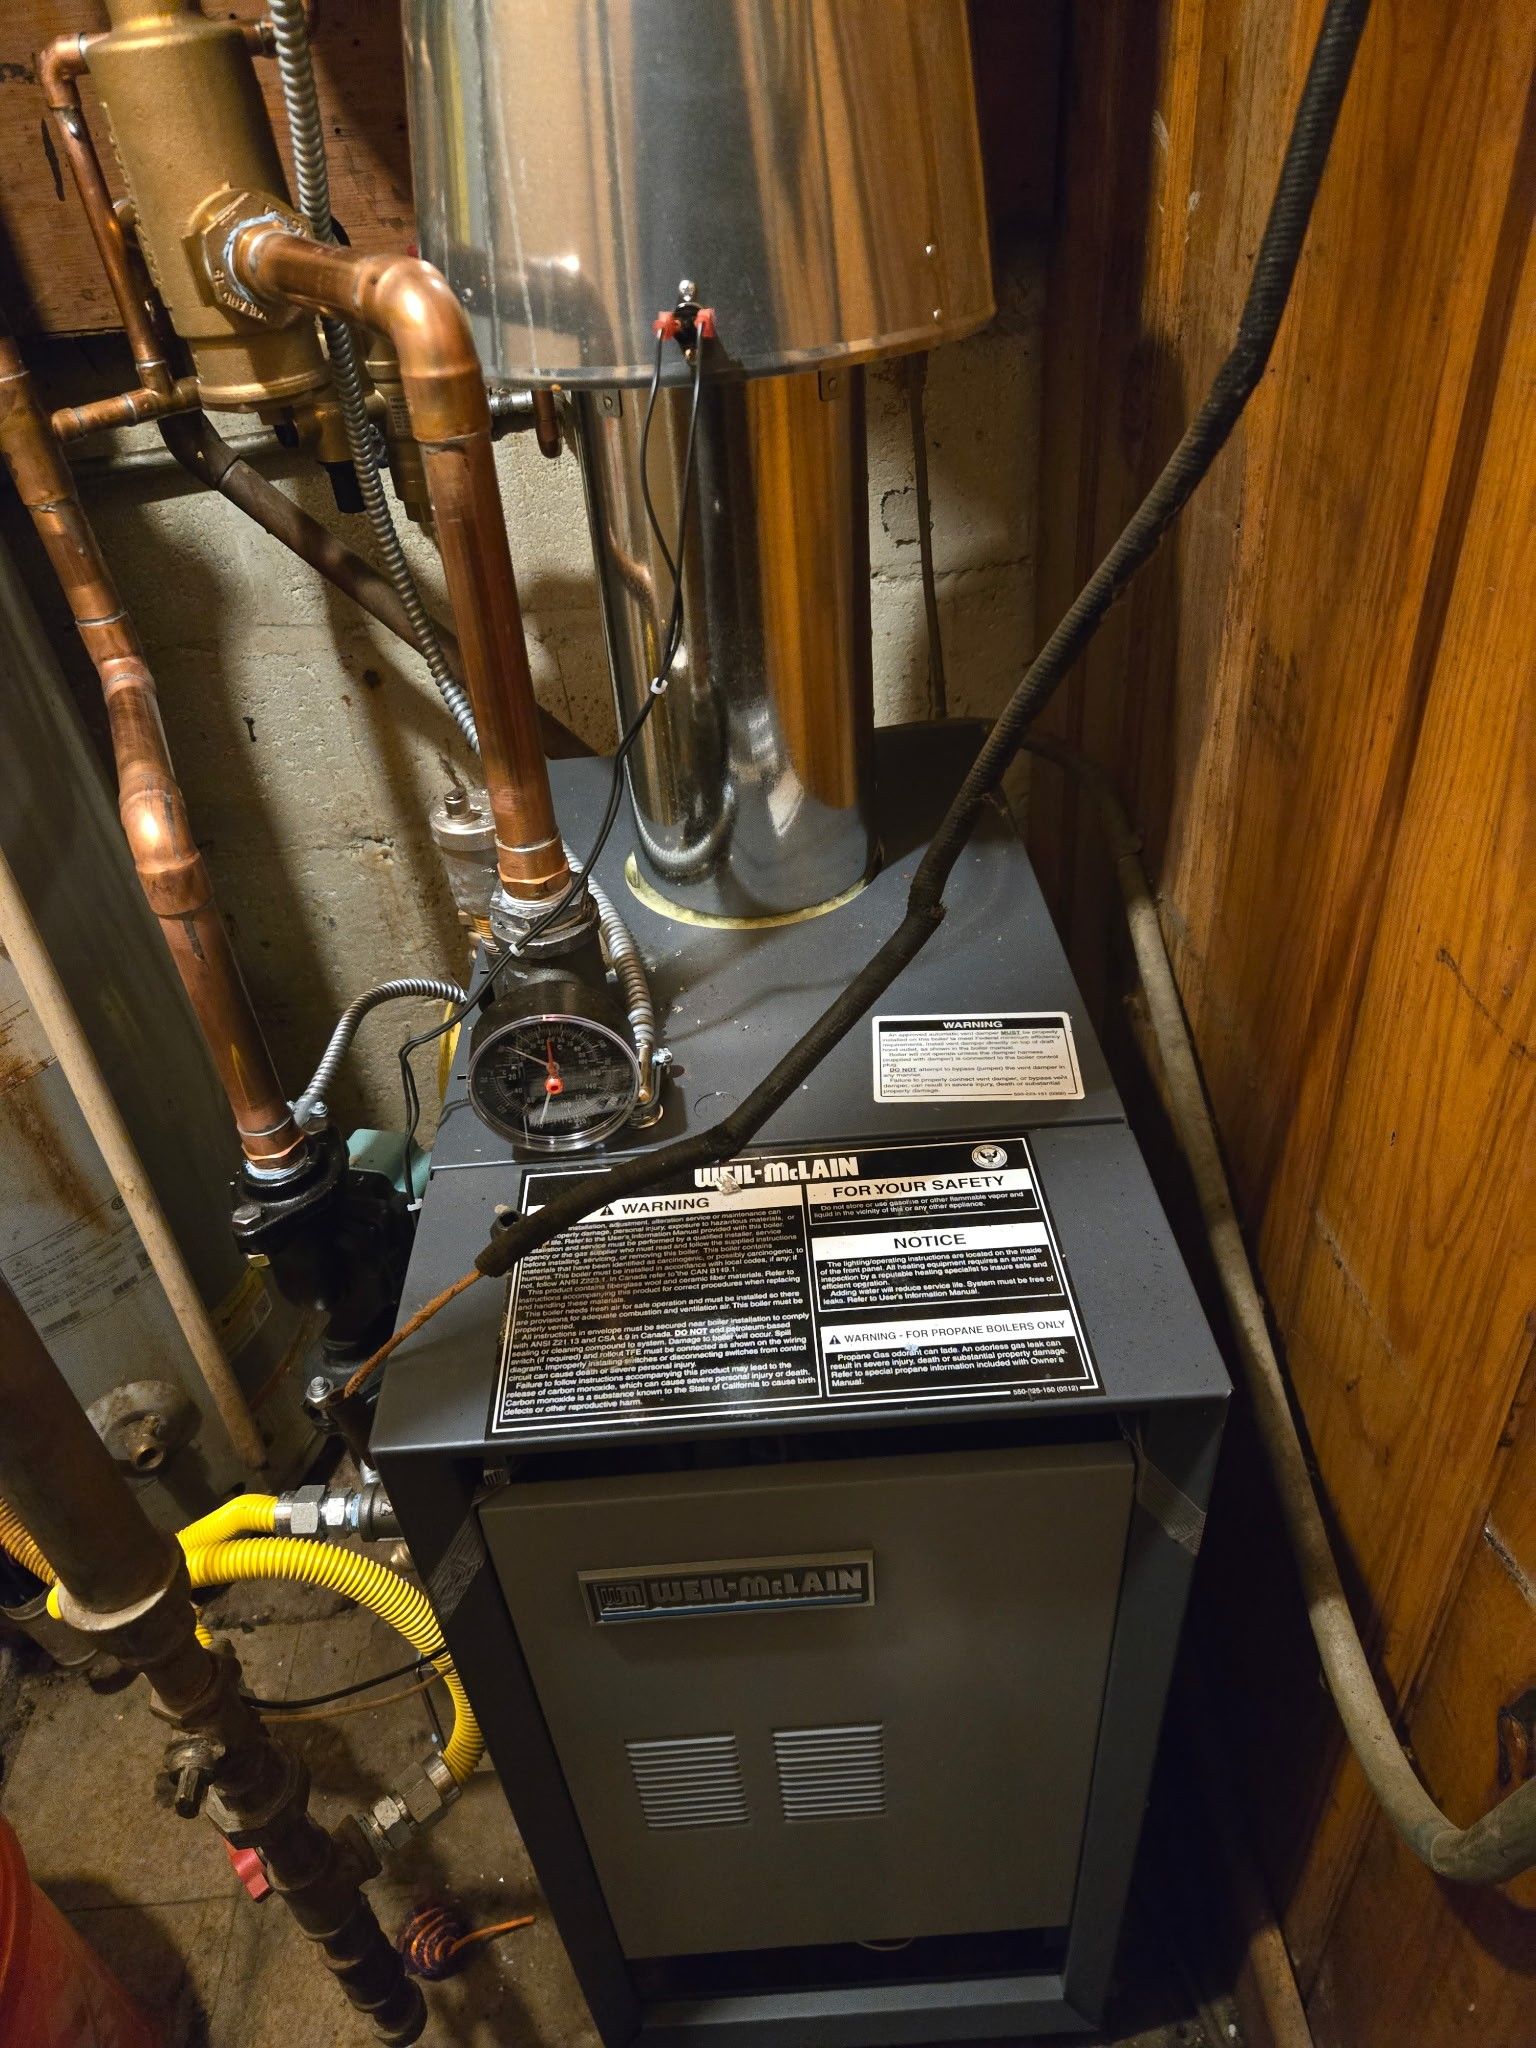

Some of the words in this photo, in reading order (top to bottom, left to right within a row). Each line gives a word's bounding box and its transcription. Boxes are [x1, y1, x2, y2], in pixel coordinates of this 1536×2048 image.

[943, 1021, 1004, 1029] WARNING
[833, 1185, 872, 1198] FOR
[875, 1181, 927, 1195] YOUR
[932, 1176, 1006, 1191] SAFETY
[622, 1198, 709, 1214] WARNING
[855, 1207, 881, 1216] vicinity
[948, 1200, 986, 1210] appliance.
[894, 1234, 967, 1249] NOTICE
[827, 1260, 842, 1268] The
[907, 1253, 951, 1262] instructions
[1019, 1246, 1043, 1254] inside
[829, 1267, 842, 1275] the
[842, 1266, 861, 1274] front
[897, 1262, 926, 1271] heating
[926, 1259, 967, 1269] equipment
[967, 1257, 1000, 1267] requires
[1010, 1254, 1038, 1262] annual
[820, 1274, 860, 1284] inspection
[860, 1273, 870, 1281] by
[914, 1268, 944, 1278] heating
[989, 1263, 1014, 1271] insure
[1032, 1260, 1049, 1268] and
[830, 1288, 858, 1298] Adding
[858, 1287, 880, 1295] water
[894, 1284, 922, 1292] reduce
[922, 1282, 952, 1291] service
[966, 1279, 997, 1289] System
[996, 1277, 1017, 1285] must
[1028, 1275, 1046, 1283] free
[846, 1295, 868, 1303] Refer
[904, 1289, 948, 1299] Information
[674, 1329, 688, 1337] DO
[689, 1327, 708, 1336] NOT
[844, 1331, 897, 1343] WARNING
[905, 1329, 929, 1339] FOR
[931, 1326, 984, 1337] PROPANE
[986, 1322, 1035, 1333] BOILERS
[1036, 1320, 1067, 1330] ONLY
[829, 1361, 853, 1370] result
[853, 1361, 862, 1369] in
[863, 1360, 891, 1368] severe
[916, 1355, 941, 1364] death
[996, 1349, 1032, 1360] property
[837, 1352, 872, 1363] Propane
[872, 1350, 891, 1359] Gas
[961, 1345, 974, 1353] An
[974, 1342, 1010, 1352] odorless
[1010, 1343, 1027, 1351] gas
[1026, 1340, 1045, 1348] leak
[831, 1370, 853, 1379] Refer
[854, 1369, 864, 1377] to
[864, 1367, 894, 1378] special
[895, 1366, 929, 1376] propane
[930, 1361, 975, 1372] information
[976, 1359, 1011, 1369] included
[1011, 1357, 1030, 1366] with
[505, 1397, 536, 1407] Carbon
[536, 1394, 577, 1405] monoxide
[577, 1393, 585, 1401] is
[593, 1390, 635, 1400] substance
[636, 1387, 663, 1397] known
[664, 1387, 673, 1395] to
[674, 1385, 688, 1394] the
[688, 1384, 711, 1393] State
[711, 1383, 721, 1391] of
[761, 1379, 771, 1387] to
[797, 1376, 817, 1384] birth
[537, 1388, 547, 1396] of
[619, 1381, 643, 1390] which
[751, 1370, 774, 1381] injury
[652, 1568, 862, 1603] WEIL-McLAIN
